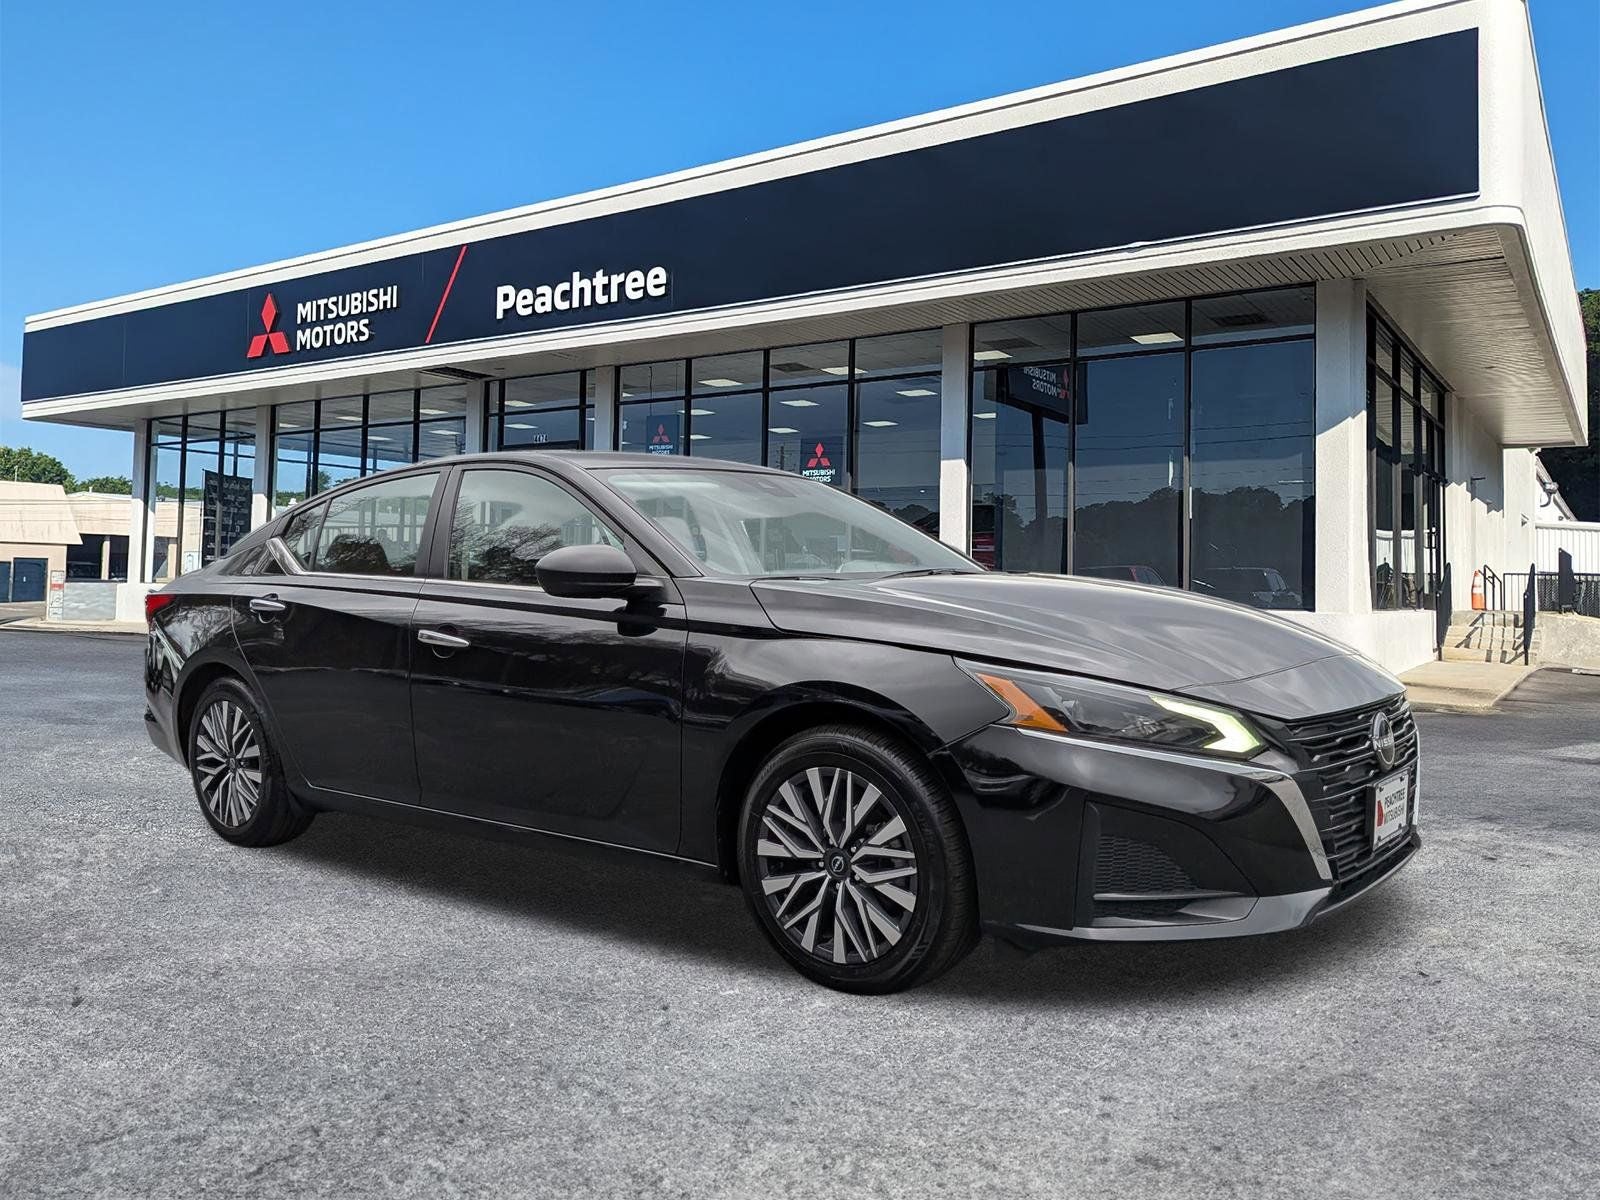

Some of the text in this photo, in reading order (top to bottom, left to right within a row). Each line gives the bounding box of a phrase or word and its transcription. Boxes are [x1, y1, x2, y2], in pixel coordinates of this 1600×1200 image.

[296, 285, 398, 325] MITSUBISHI
[496, 266, 667, 320] Peachtree
[296, 318, 370, 351] MOTORS
[802, 468, 836, 477] MITSUBISHI
[1384, 788, 1406, 808] PEACHTREE
